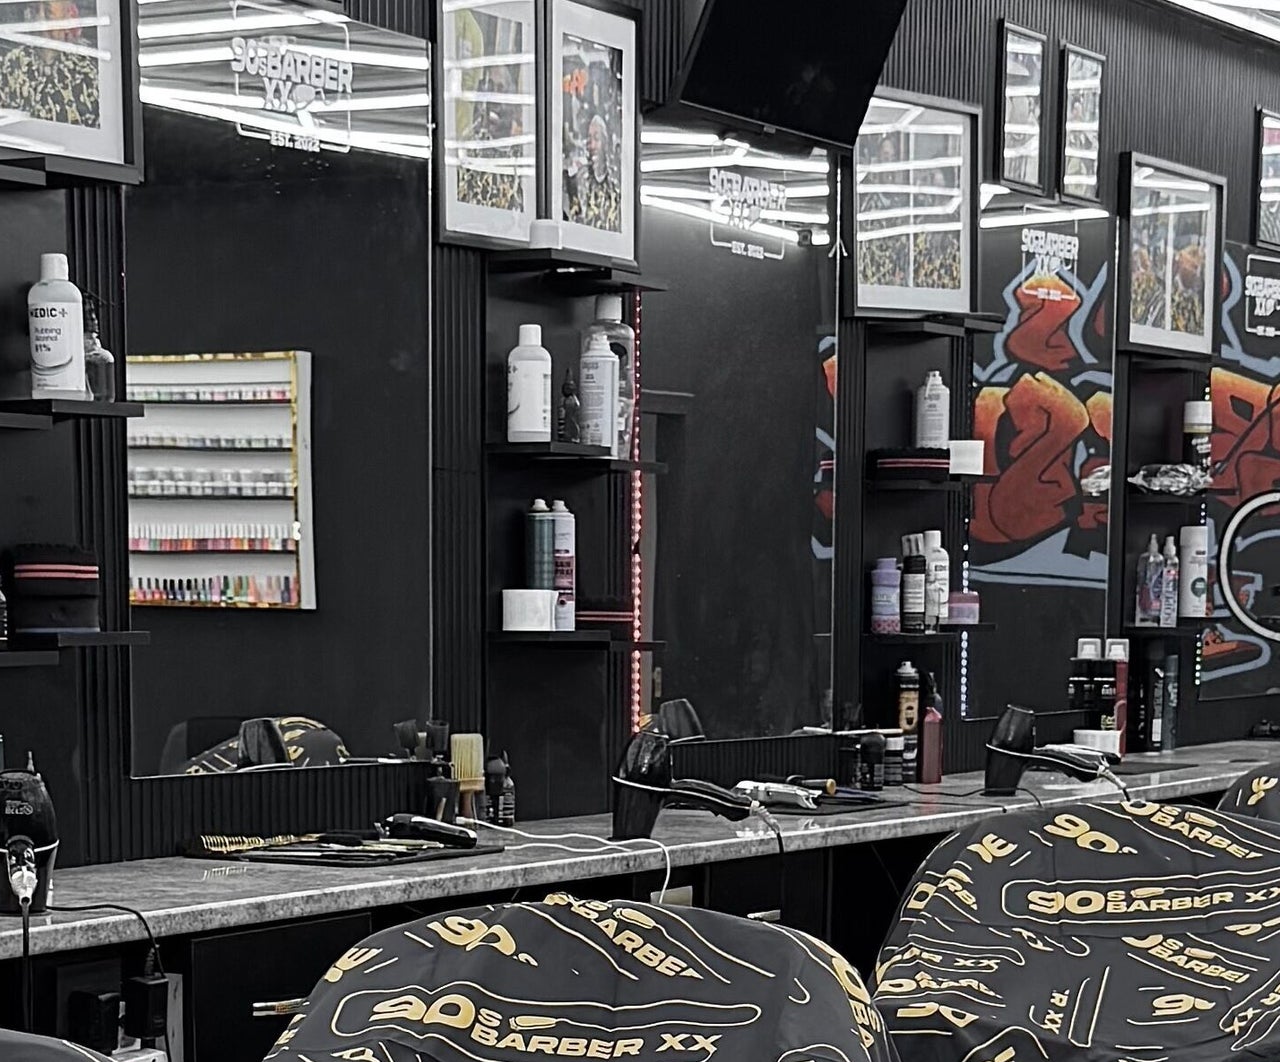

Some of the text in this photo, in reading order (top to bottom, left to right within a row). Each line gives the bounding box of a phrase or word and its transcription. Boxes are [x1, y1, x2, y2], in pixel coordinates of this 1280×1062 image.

[267, 49, 353, 94] BARBER
[1106, 891, 1234, 914] BARBER
[469, 1022, 644, 1060] BARBER
[656, 1032, 723, 1053] XX
